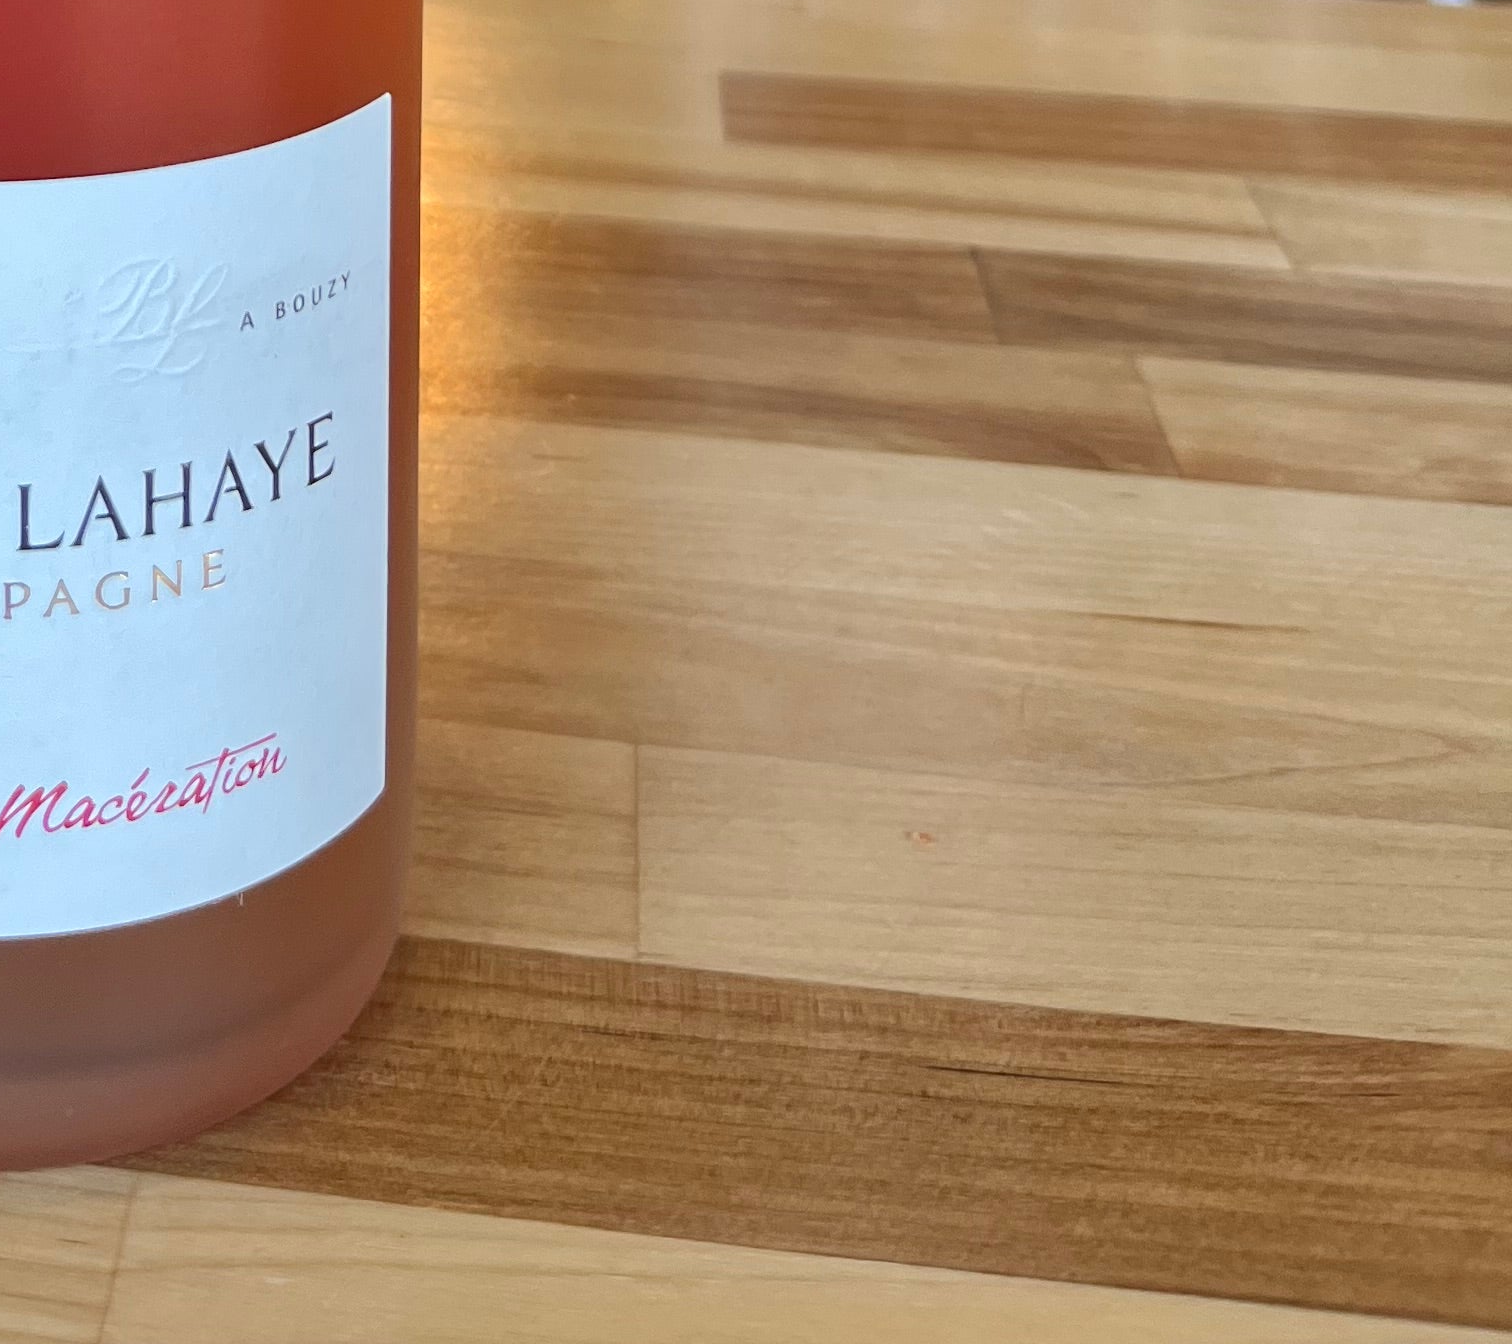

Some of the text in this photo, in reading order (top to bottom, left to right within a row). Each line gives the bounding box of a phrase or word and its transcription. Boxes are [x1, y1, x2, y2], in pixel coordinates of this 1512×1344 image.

[240, 269, 352, 332] A BOUZY
[15, 409, 337, 552] LAHAYE
